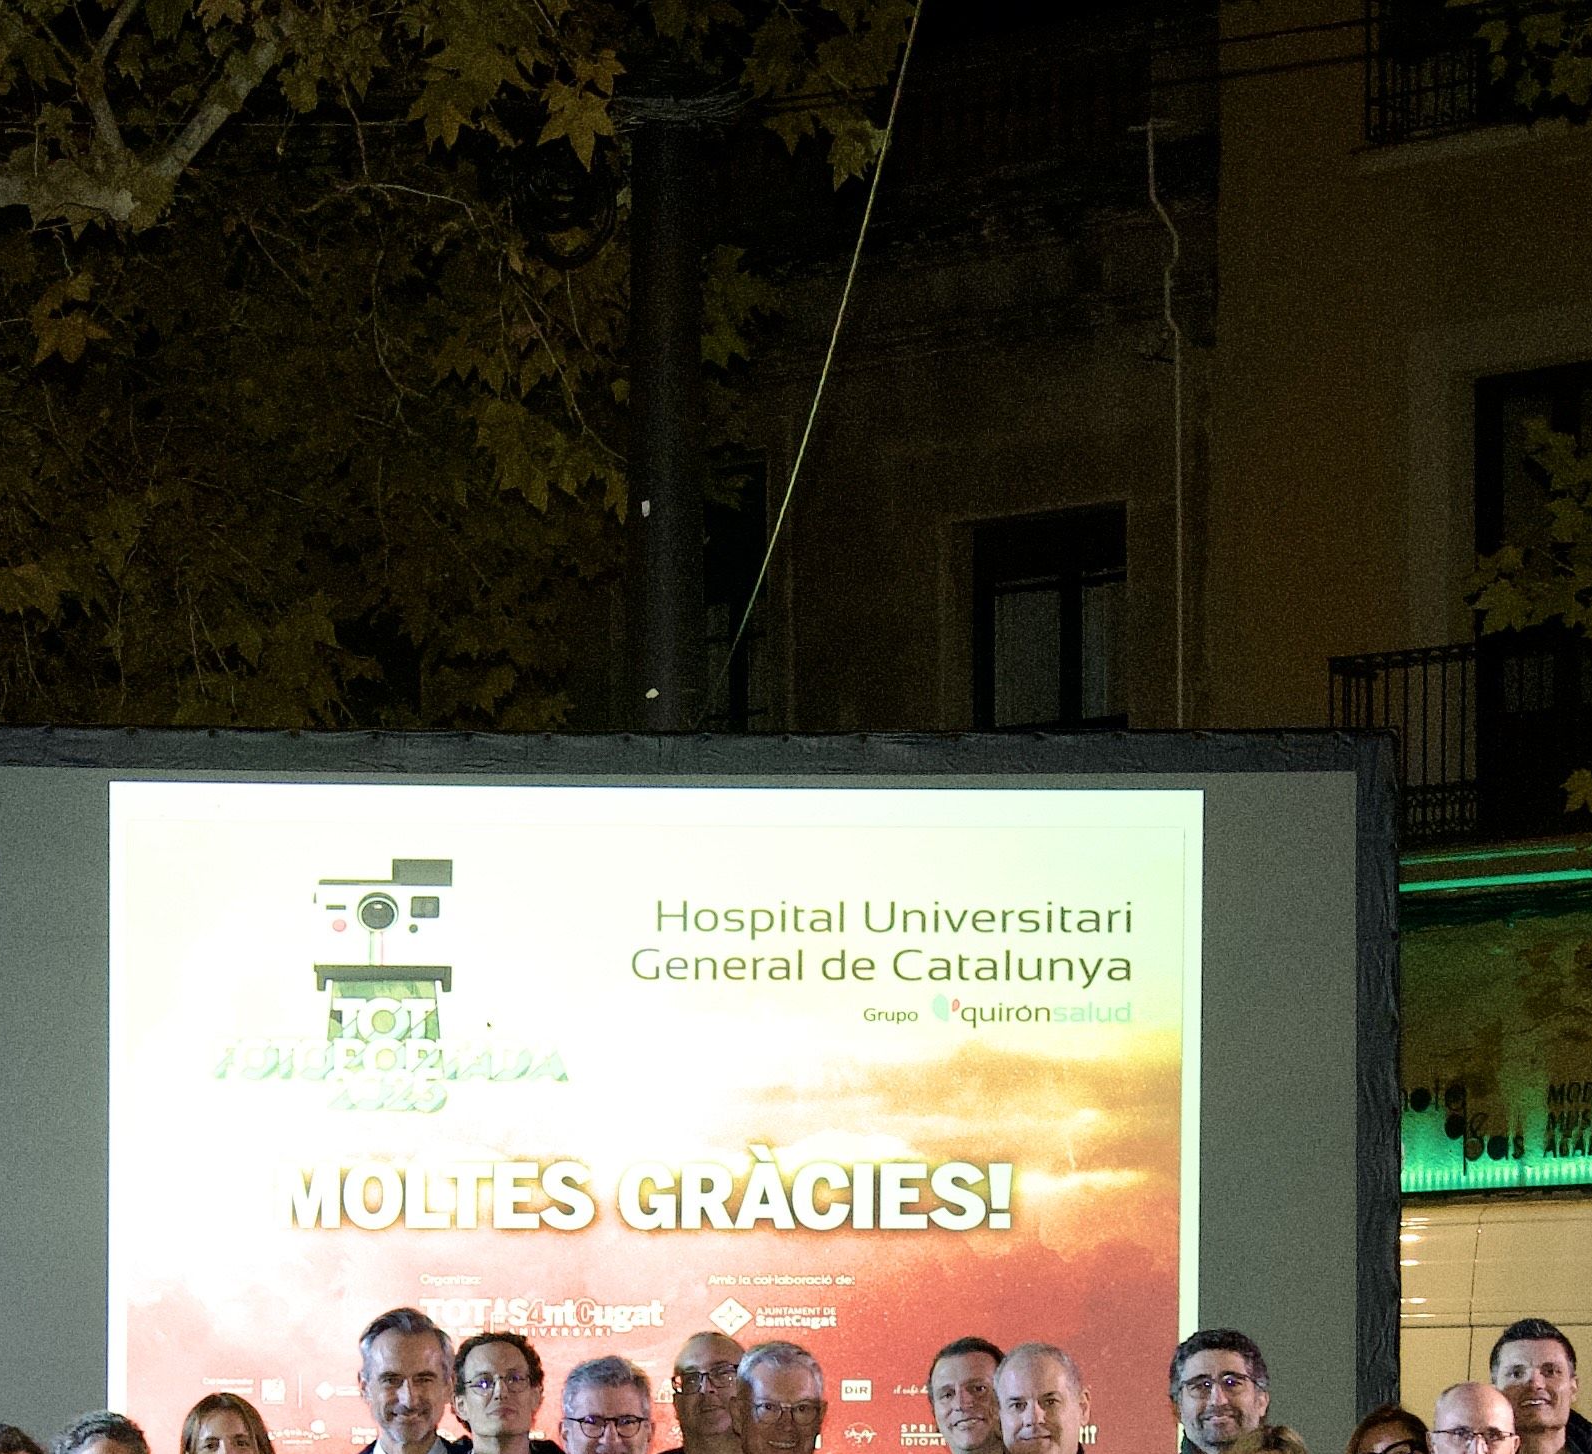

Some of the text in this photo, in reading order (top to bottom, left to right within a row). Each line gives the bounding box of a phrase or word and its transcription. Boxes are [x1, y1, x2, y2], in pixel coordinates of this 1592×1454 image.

[655, 896, 1133, 939] Hospital Universitari
[630, 945, 1133, 991] General de Catalunya
[862, 998, 1132, 1030] Grupo quirónsalud
[290, 1144, 1014, 1231] MOLTES GRÀCIES!
[707, 1274, 737, 1286] Amb
[738, 1274, 751, 1286] la
[835, 1274, 856, 1286] de:
[419, 1297, 492, 1327] TOT
[756, 1306, 837, 1316] AJUNTAMENT DE
[900, 1423, 934, 1433] SPRI
[900, 1437, 947, 1446] IDIOME
